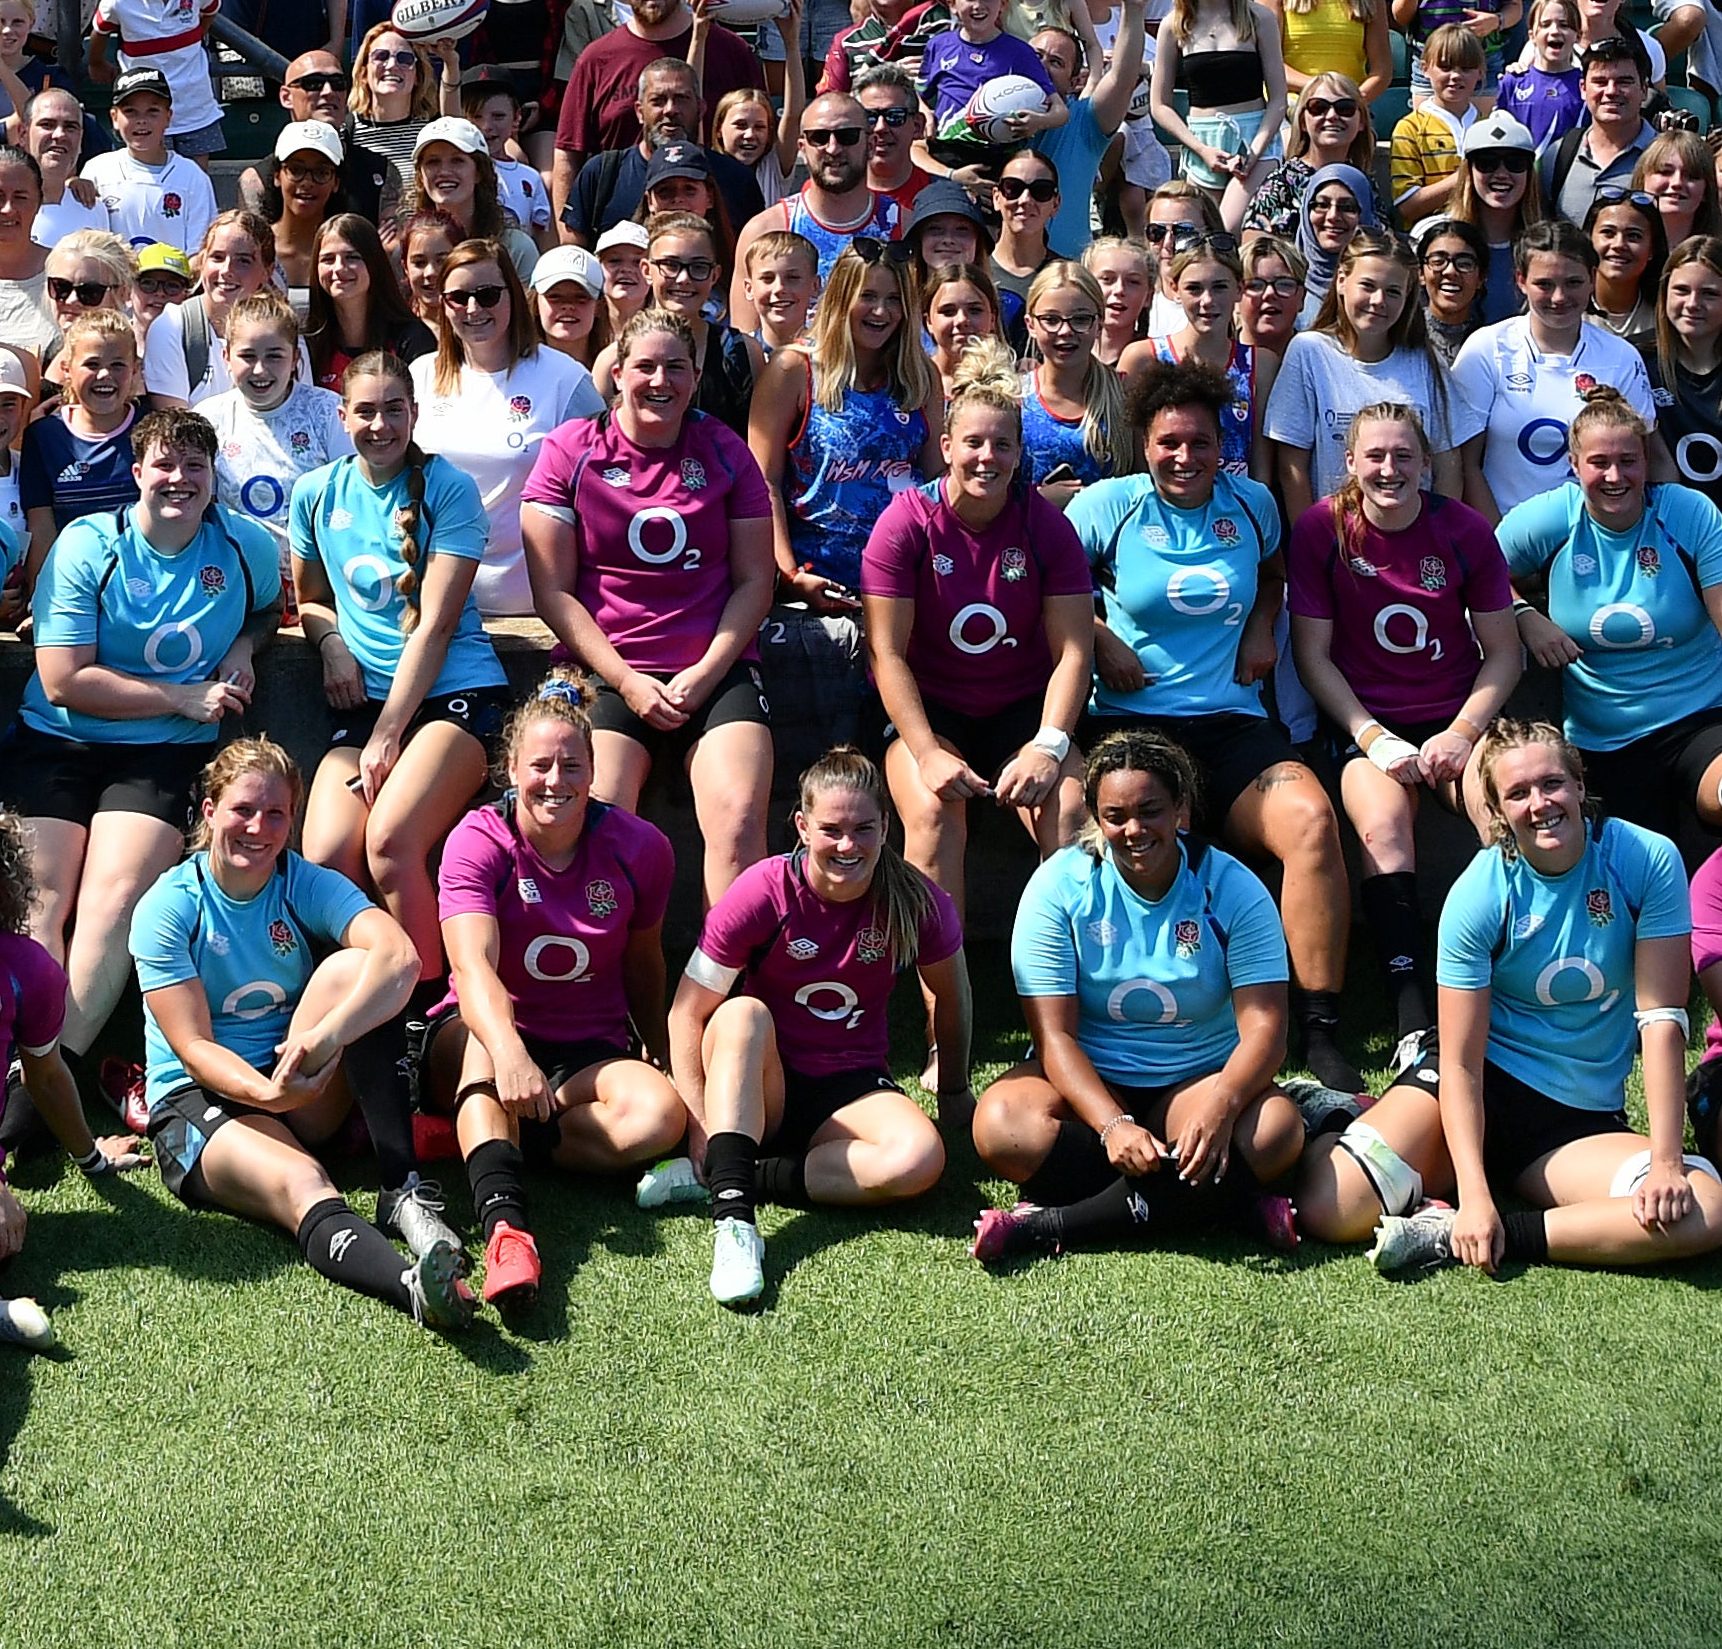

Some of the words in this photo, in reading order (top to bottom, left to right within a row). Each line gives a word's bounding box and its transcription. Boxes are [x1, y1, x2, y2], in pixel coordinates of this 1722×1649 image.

[506, 431, 529, 453] O2
[628, 506, 702, 570] O2
[1166, 568, 1245, 628] O2
[145, 622, 208, 673] O
[1374, 603, 1446, 660] O2
